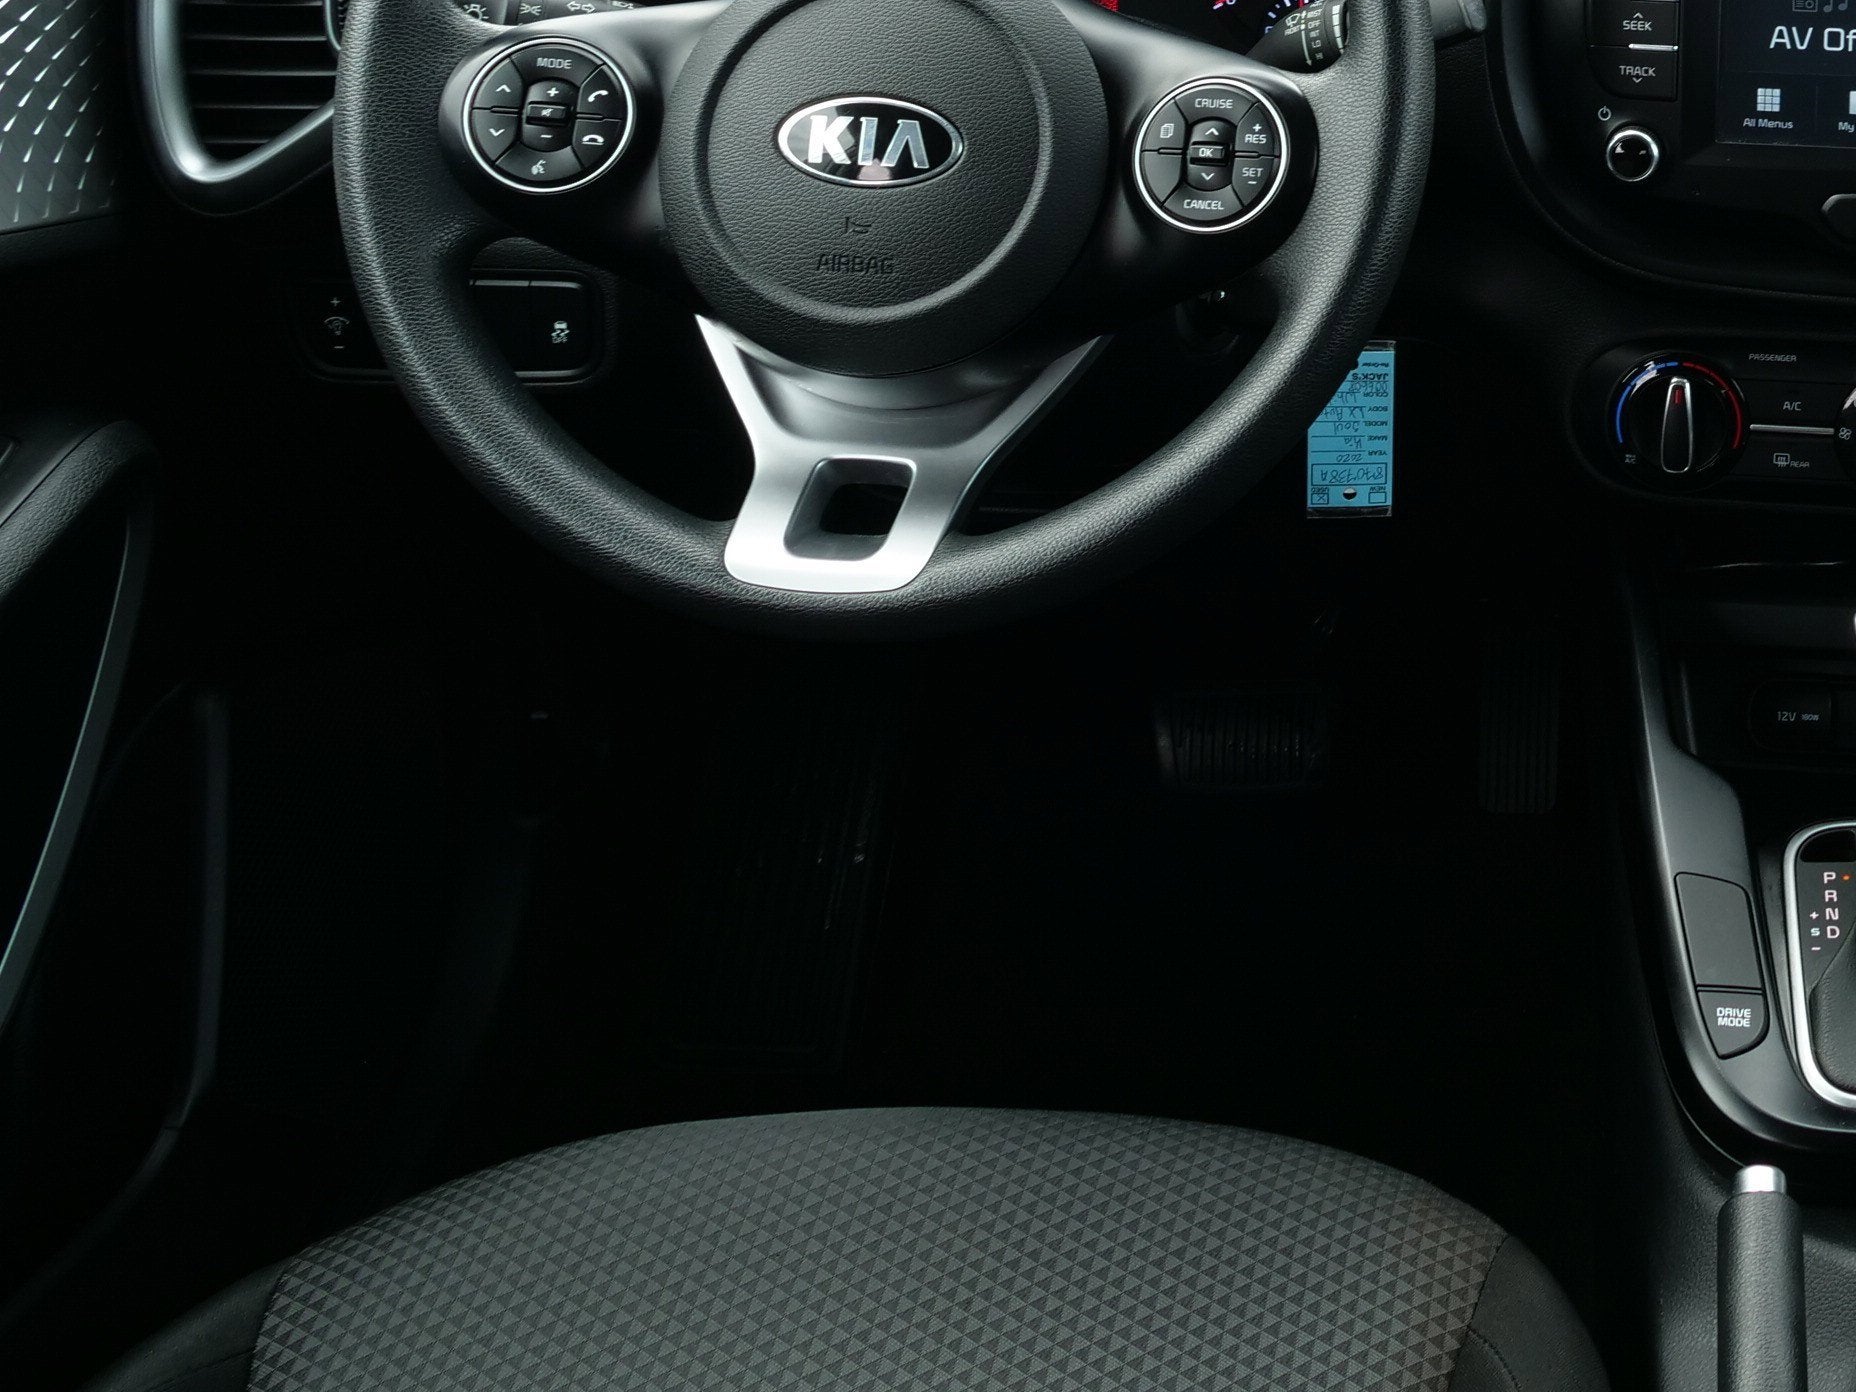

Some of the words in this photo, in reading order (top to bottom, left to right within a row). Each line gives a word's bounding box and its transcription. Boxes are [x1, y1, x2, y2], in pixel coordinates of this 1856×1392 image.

[1622, 20, 1652, 32] SEEK
[1769, 25, 1813, 50] AV
[536, 57, 573, 70] MODE
[1618, 65, 1656, 77] TRACK
[1194, 98, 1234, 109] CRUISE
[1743, 118, 1756, 128] All
[1758, 119, 1793, 130] Menus
[1838, 122, 1854, 133] My
[807, 114, 930, 169] KIA
[1244, 133, 1267, 145] RES
[1198, 147, 1214, 158] OK
[1242, 167, 1263, 178] SET
[1183, 199, 1225, 211] CANCEL
[1749, 353, 1798, 363] PASSENGER
[1351, 372, 1389, 381] JACK'S
[1782, 401, 1802, 412] A/C
[1777, 710, 1797, 722] 12V
[1823, 871, 1837, 885] P
[1824, 890, 1838, 903] R
[1825, 909, 1840, 921] N
[1810, 927, 1820, 937] S
[1826, 926, 1840, 939] D
[1716, 1008, 1752, 1019] DRIVE
[1717, 1017, 1751, 1028] MODE
